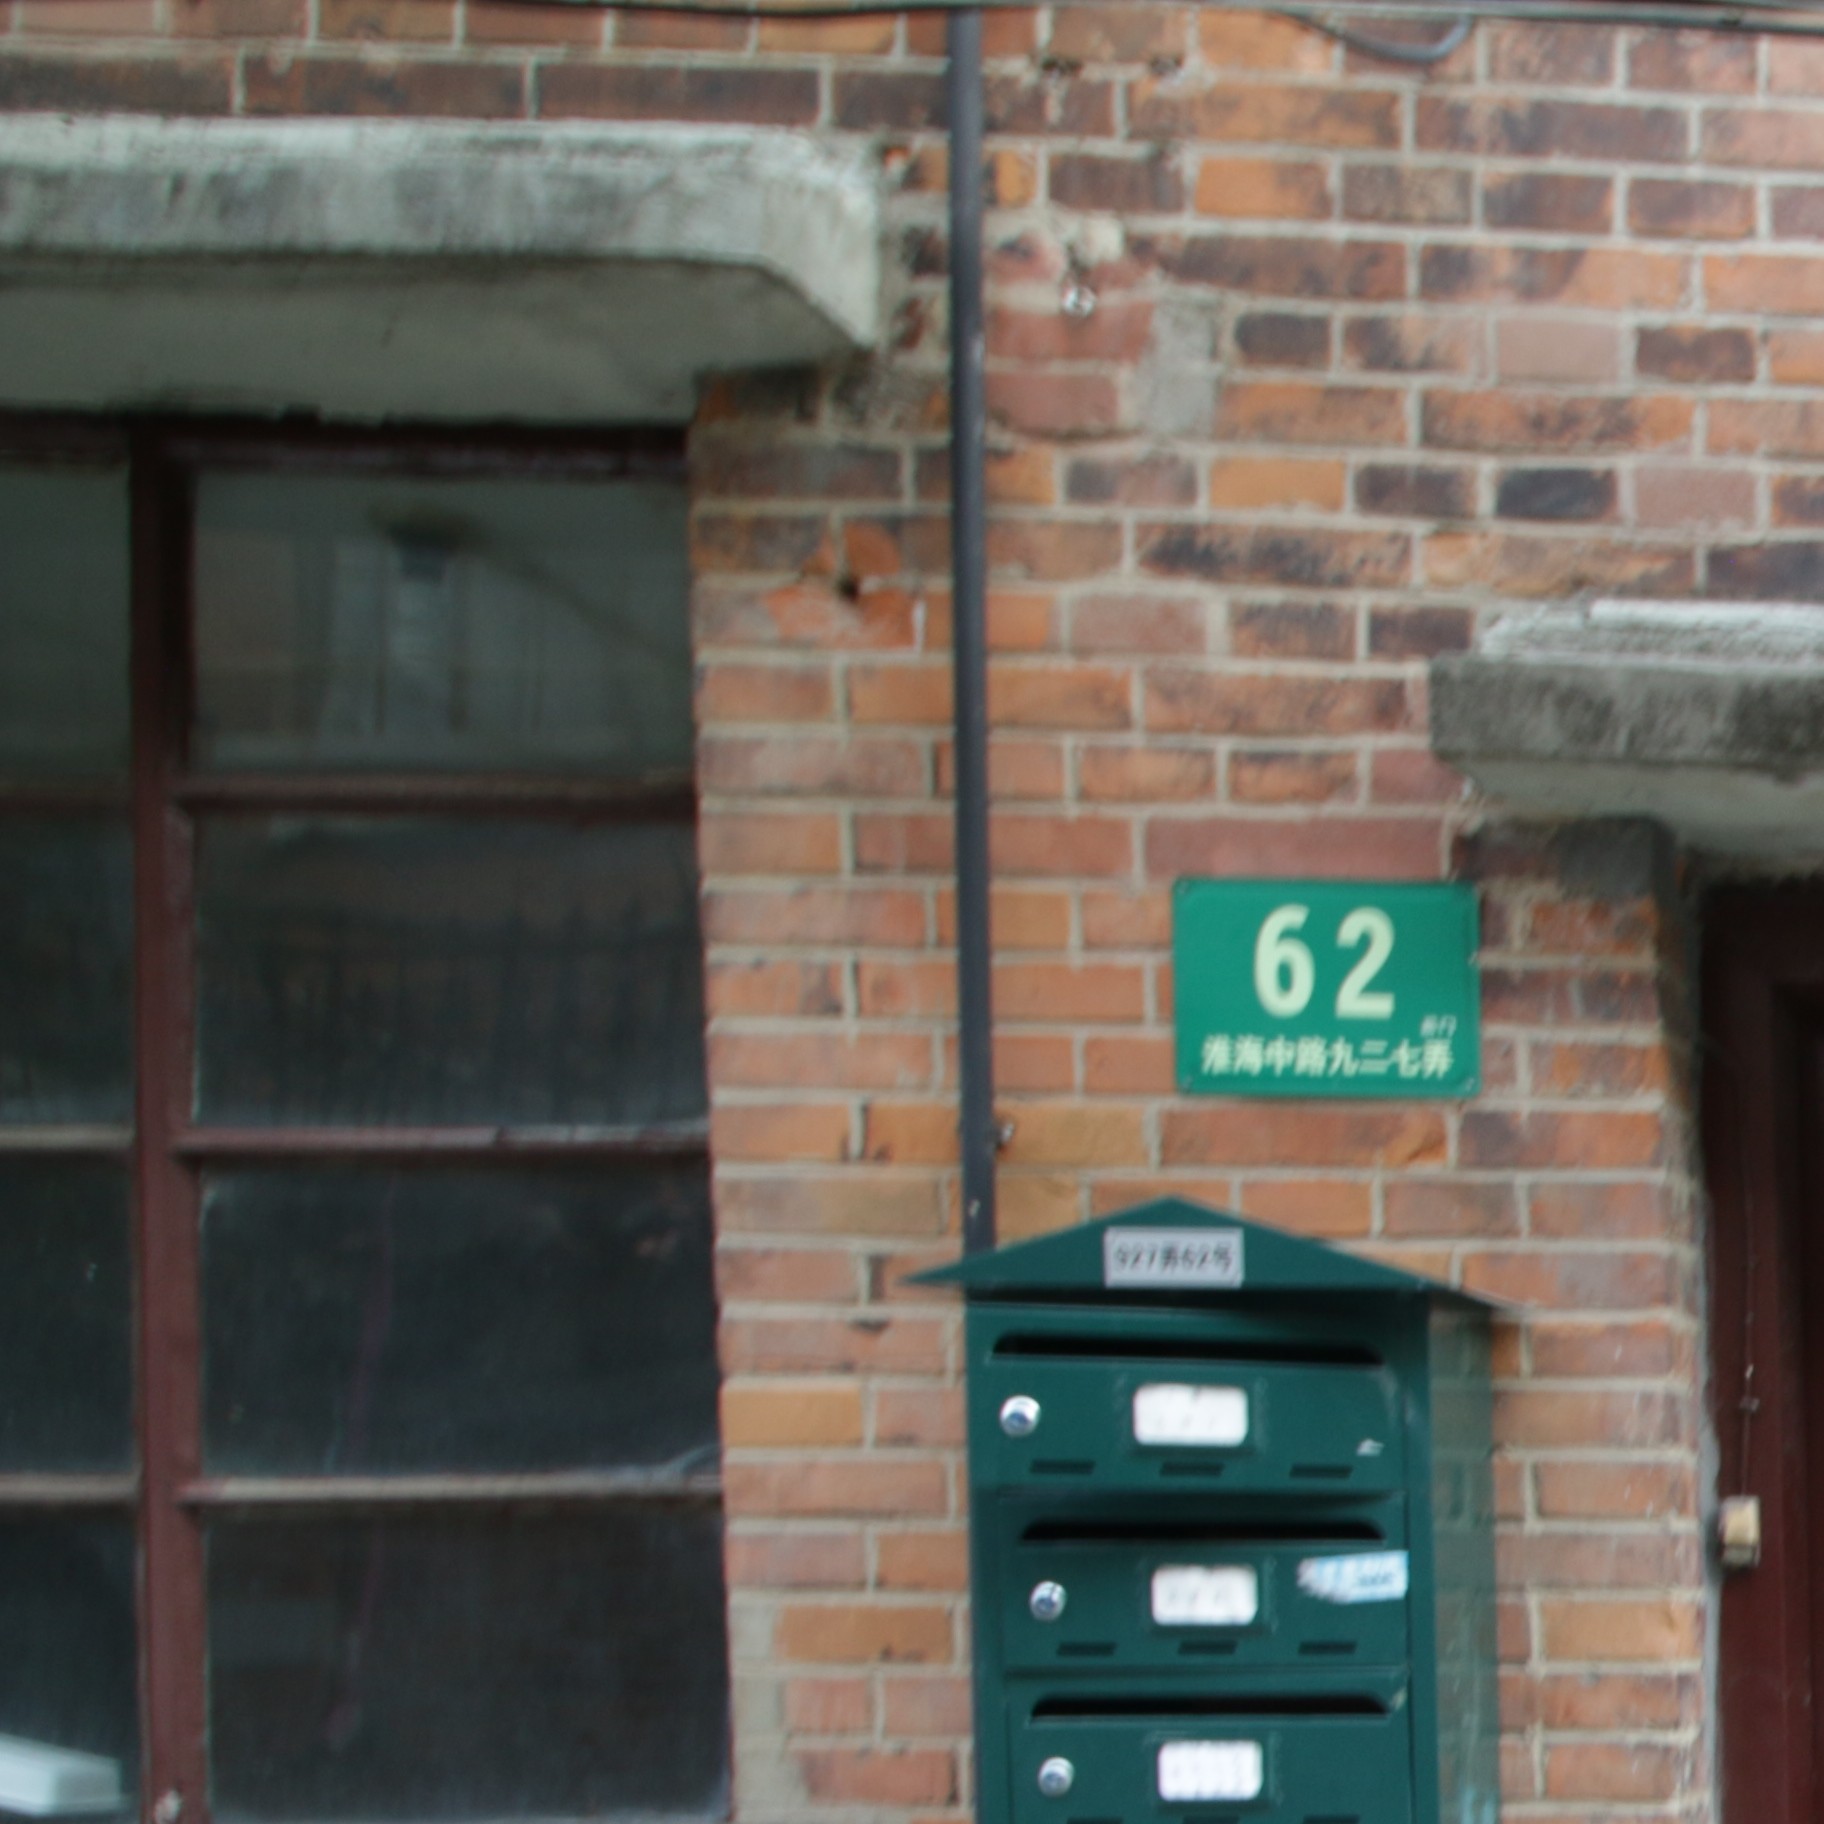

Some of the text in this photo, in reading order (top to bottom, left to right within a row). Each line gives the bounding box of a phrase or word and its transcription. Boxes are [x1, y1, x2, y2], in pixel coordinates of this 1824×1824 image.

[1253, 902, 1395, 1021] 62
[1202, 1032, 1455, 1079] 淮海中路九二七弄
